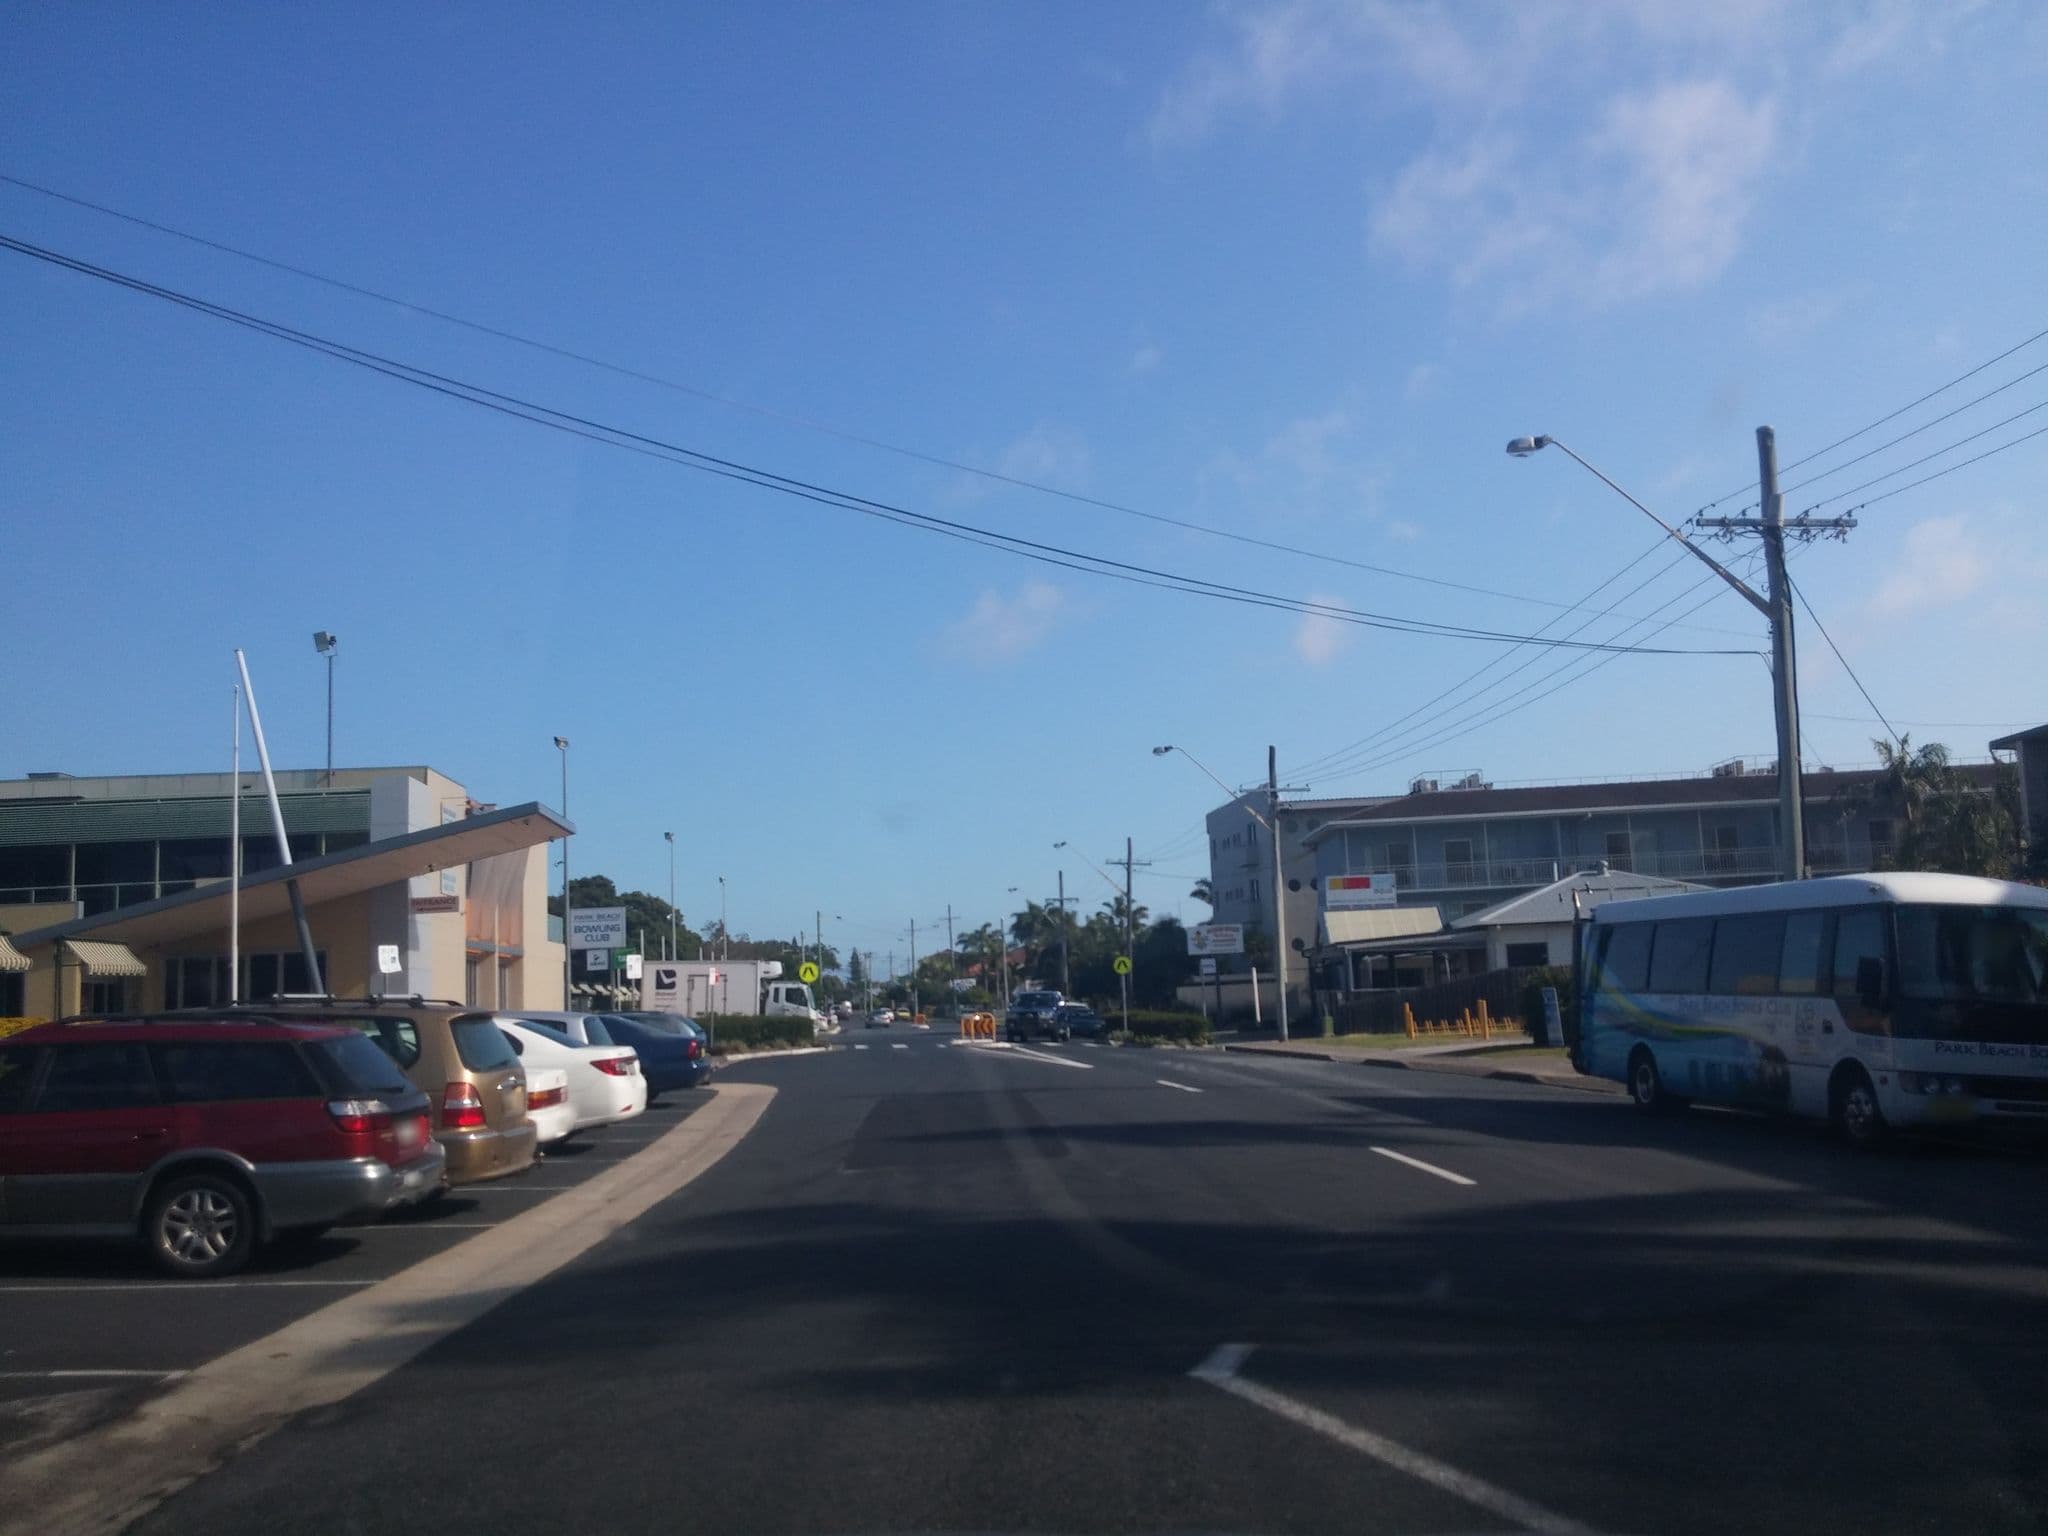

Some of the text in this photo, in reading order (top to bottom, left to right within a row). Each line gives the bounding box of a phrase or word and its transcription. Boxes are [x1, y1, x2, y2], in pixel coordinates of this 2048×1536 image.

[573, 923, 621, 934] BOWLING
[584, 933, 610, 942] CLUB
[1935, 1041, 1976, 1055] PARK
[1978, 1042, 2027, 1056] BEACH
